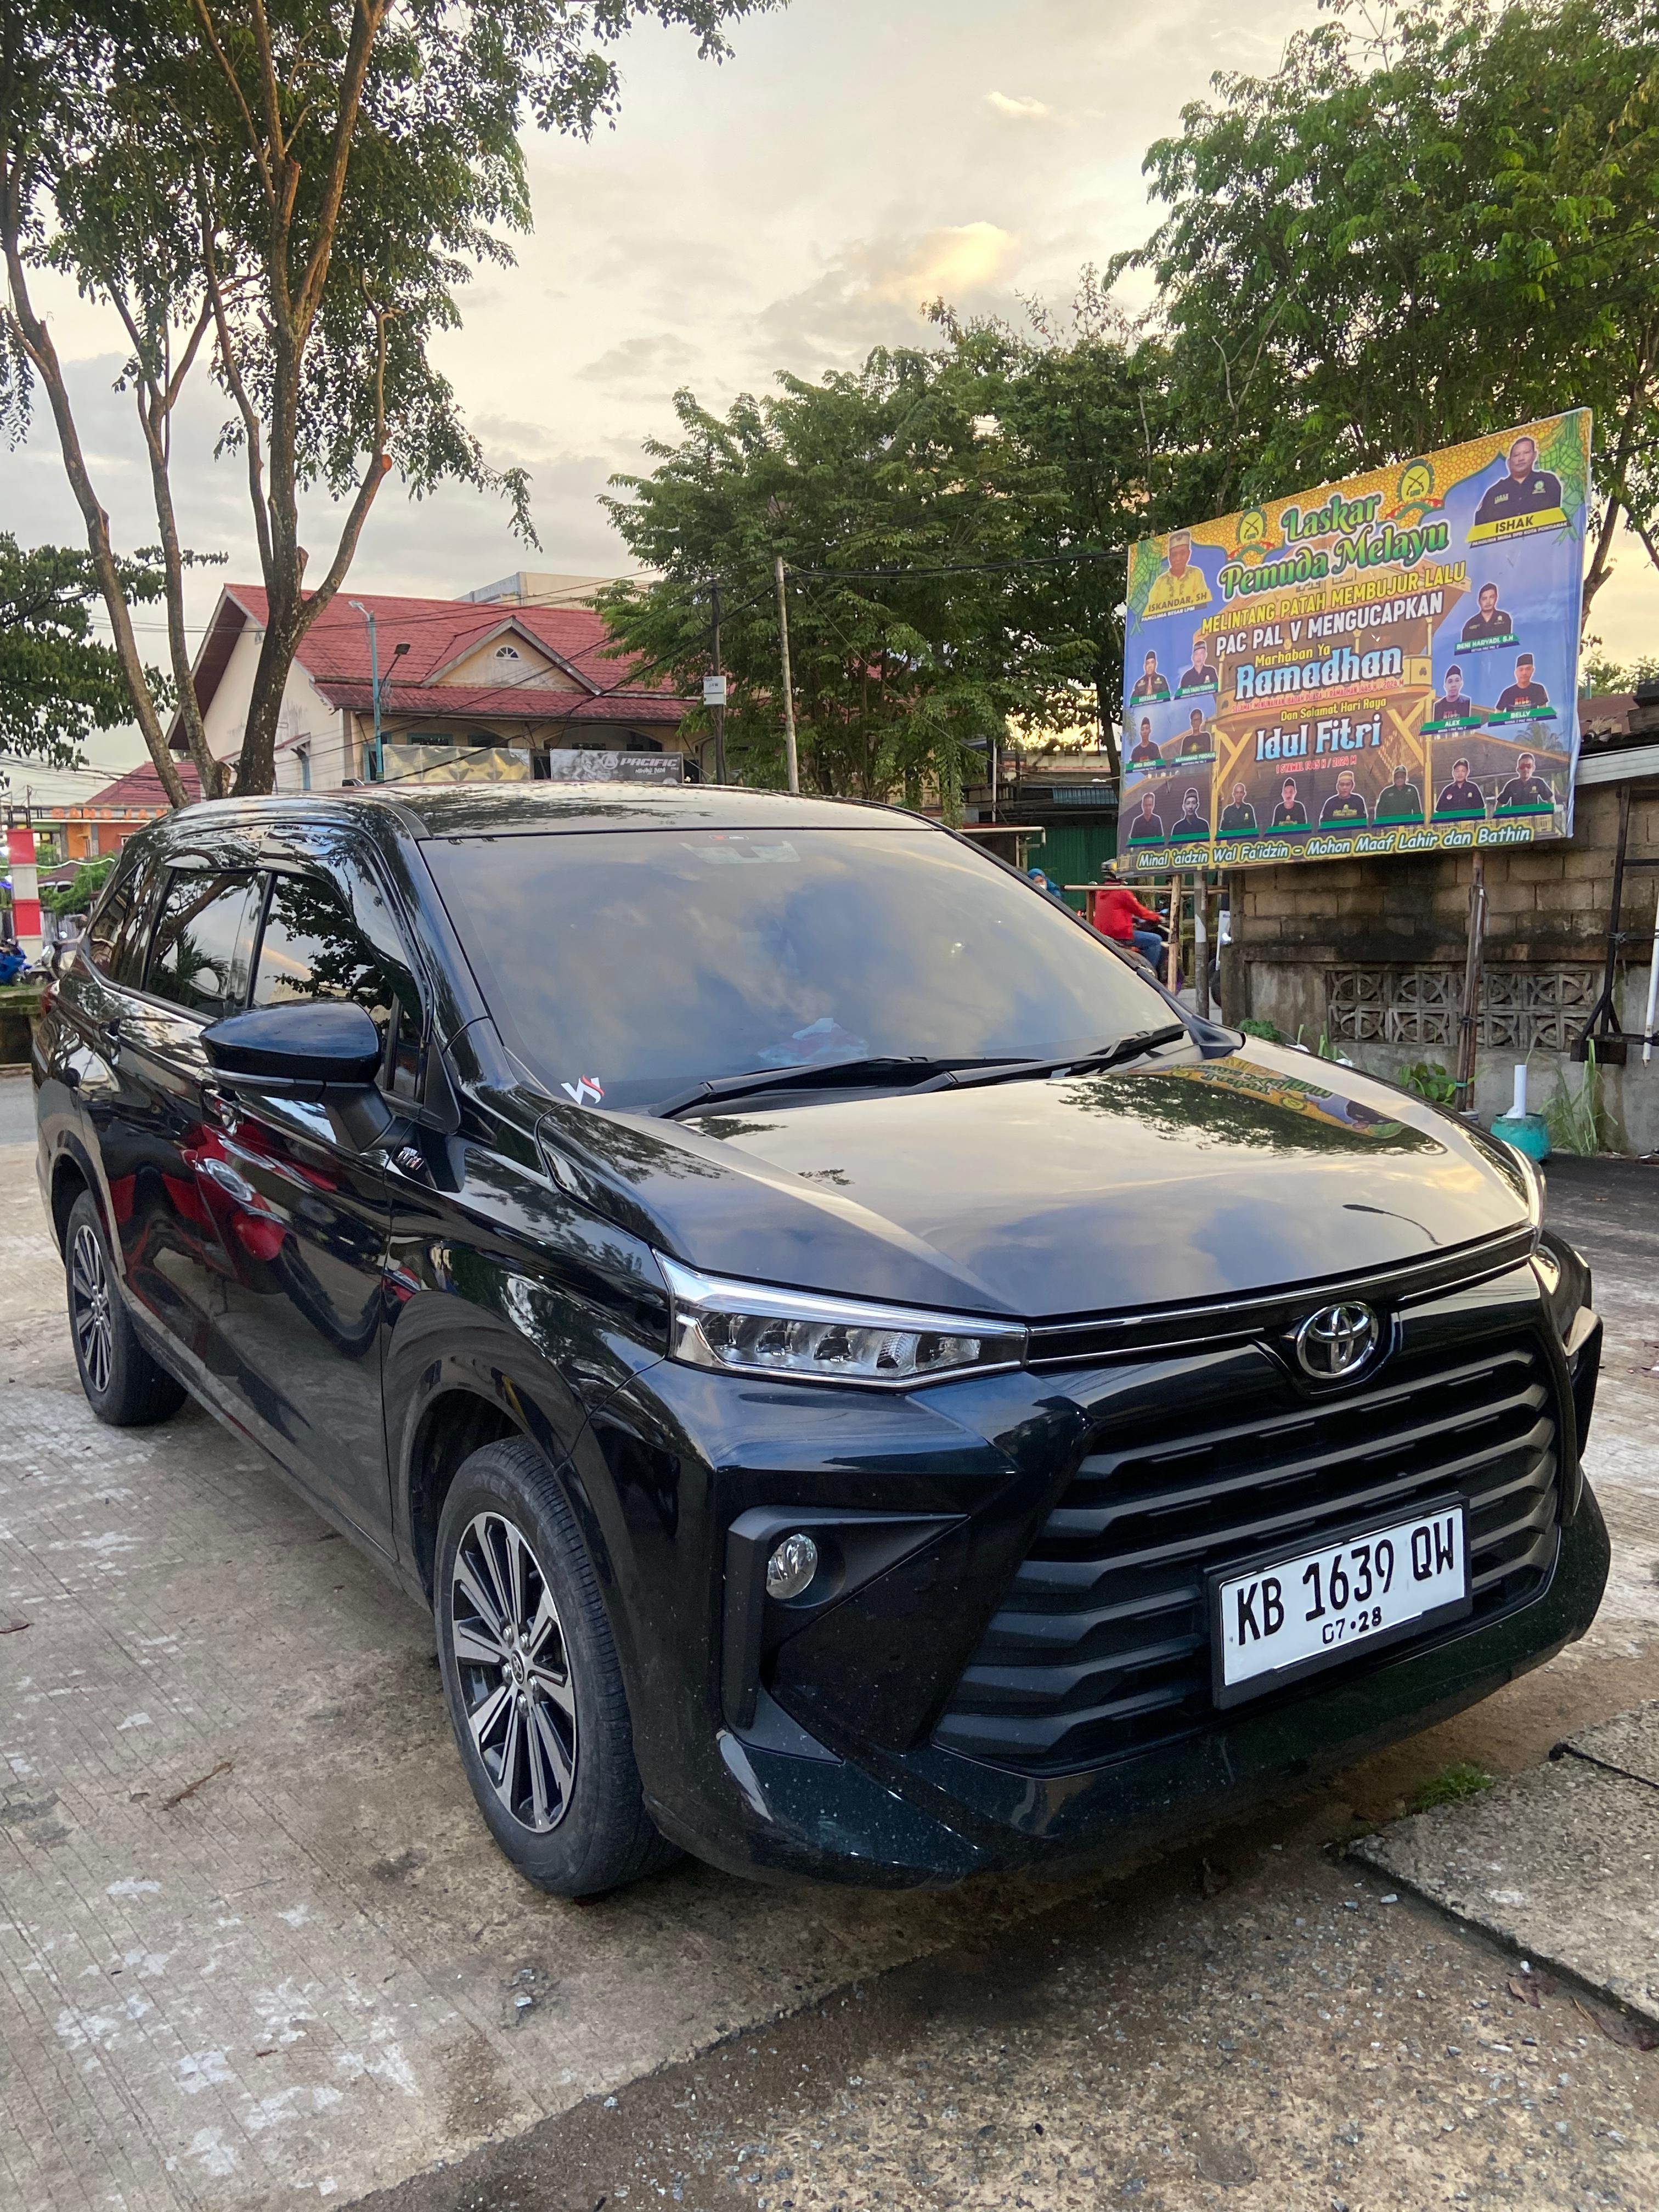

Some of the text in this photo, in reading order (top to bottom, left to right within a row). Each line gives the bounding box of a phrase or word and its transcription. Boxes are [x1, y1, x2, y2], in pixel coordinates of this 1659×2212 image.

[1281, 494, 1381, 543] Laskar
[1496, 515, 1534, 533] ISHAK
[1219, 522, 1449, 599] Pemuda Melayu
[1196, 592, 1207, 601] SH
[1201, 561, 1466, 635] MELINTANG PATAH MEMBUJUR LALU
[1216, 591, 1443, 657] PAC PAL V MENGUCAPKAN
[1255, 643, 1331, 668] Marhaban Ya
[1235, 647, 1402, 701] Ramadhan
[1254, 698, 1285, 709] MENUNAIKAN
[1306, 692, 1322, 701] PUASA
[1329, 687, 1357, 698] RAMADHAN
[1280, 710, 1298, 721] Dan
[1340, 700, 1361, 713] Hari
[1363, 698, 1386, 710] Raya
[1255, 714, 1381, 761] Idul Fitri
[620, 758, 678, 766] PACIFIC
[1280, 762, 1304, 773] SYAWAL
[1321, 758, 1326, 769] H
[1333, 756, 1349, 766] 2024
[1350, 755, 1357, 765] M
[52, 808, 112, 819] GANG
[1139, 853, 1167, 867] Minal
[1172, 850, 1208, 865] 'aidzin
[1213, 848, 1235, 862] Wal
[1241, 844, 1288, 861] Fa'idzin
[1307, 838, 1350, 855] Mohon
[1356, 834, 1396, 853] Maaf
[1399, 832, 1438, 850] Lahir
[1444, 830, 1470, 845] dan
[1478, 826, 1531, 844] Bathin
[1237, 1517, 1454, 1646] KB 1639 QW
